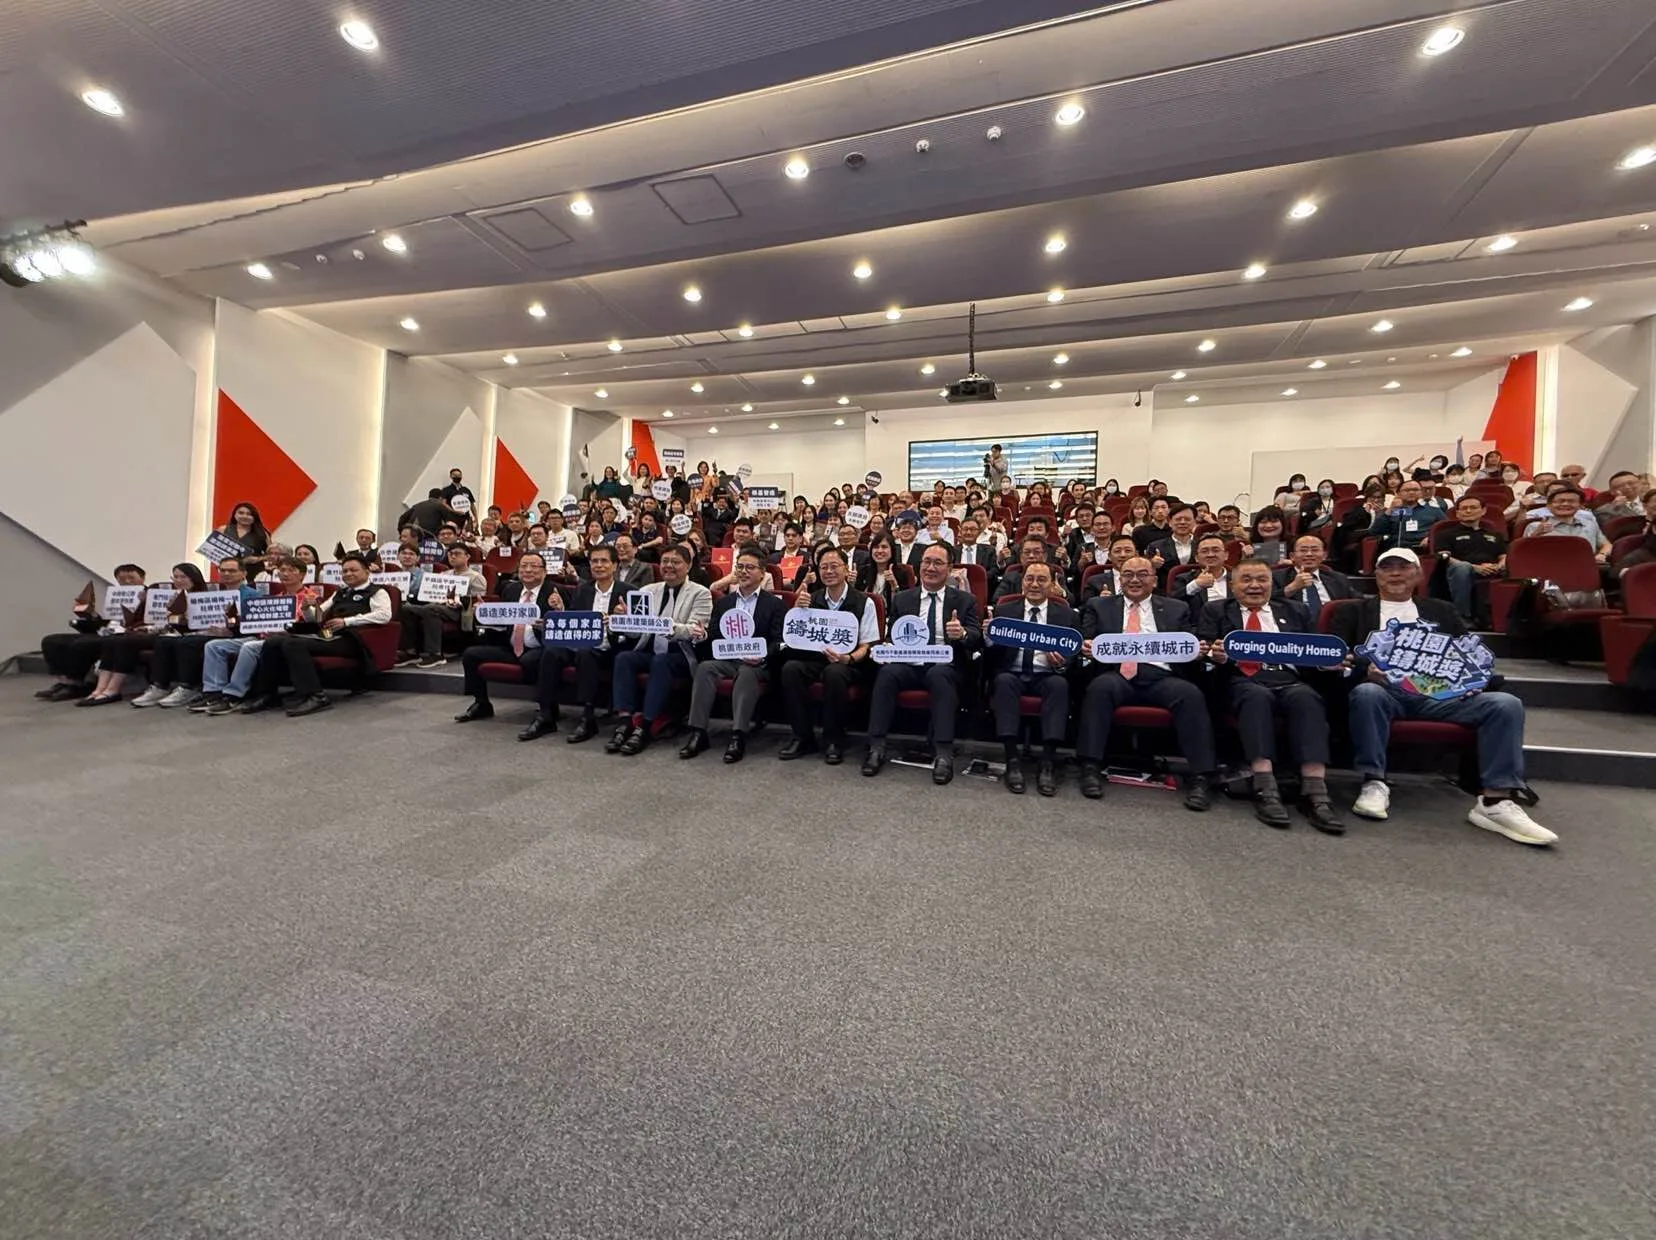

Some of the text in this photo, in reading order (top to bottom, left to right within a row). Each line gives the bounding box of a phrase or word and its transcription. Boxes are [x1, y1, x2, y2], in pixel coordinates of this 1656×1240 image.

[479, 606, 537, 619] 鑄造美好家園
[545, 618, 602, 629] 為每個家庭
[611, 616, 670, 628] 桃園市建築師公會
[808, 616, 828, 625] 桃園
[545, 629, 601, 641] 鑄造值得的家
[786, 619, 853, 646] 鑄城獎
[990, 625, 1078, 651] Building Urban City
[718, 642, 760, 653] 桃園市政府
[1397, 626, 1449, 655] 桃園
[1096, 640, 1195, 656] 成就永續城市
[1228, 640, 1342, 659] Forging Quality Homes
[1388, 648, 1464, 680] 鑄城獎
